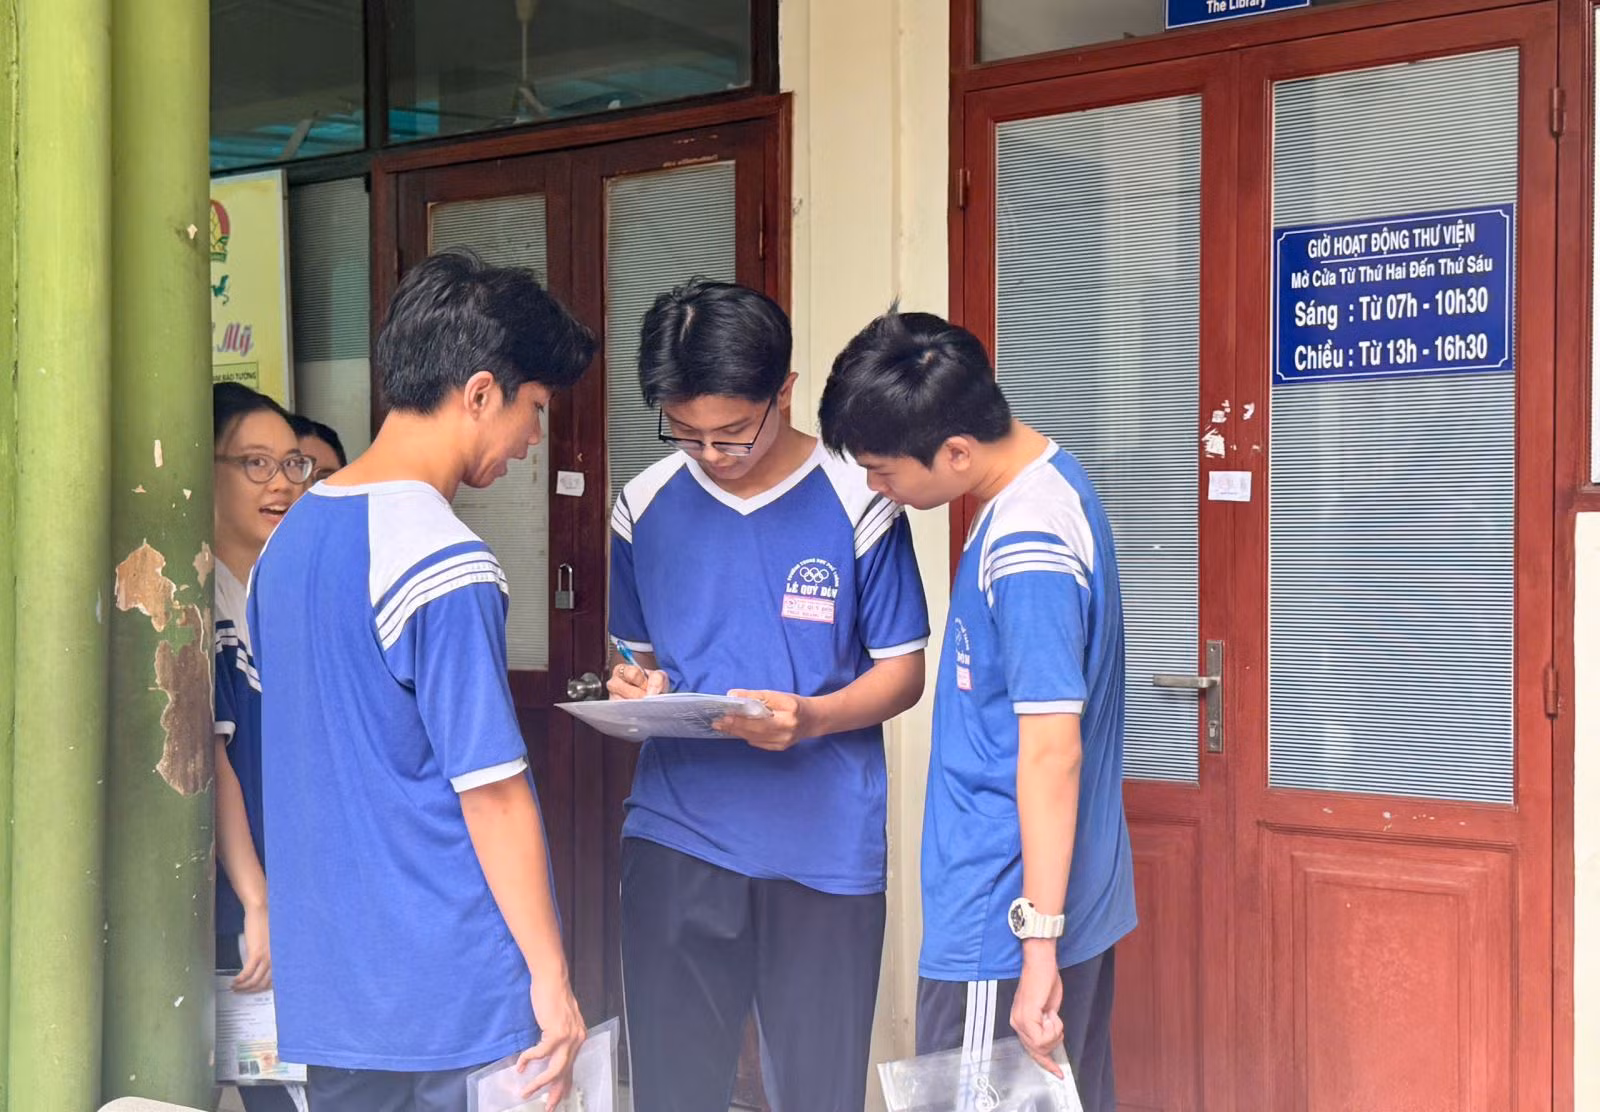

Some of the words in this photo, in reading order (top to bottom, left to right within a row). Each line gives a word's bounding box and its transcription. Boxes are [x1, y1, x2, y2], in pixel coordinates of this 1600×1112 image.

[1206, 0, 1226, 13] The
[1229, 0, 1265, 10] Library
[1308, 234, 1331, 258] GIỜ
[1334, 234, 1368, 257] HOẠT
[1371, 227, 1410, 255] ĐỘNG
[1412, 224, 1441, 248] THƯ
[1443, 219, 1475, 248] VIỆN
[1291, 270, 1310, 289] Mở
[1312, 268, 1336, 287] Cửa
[1339, 267, 1356, 285] Từ
[1358, 264, 1383, 283] Thứ
[1386, 262, 1406, 280] Hai
[1409, 258, 1435, 278] Đến
[1438, 256, 1465, 275] Thứ
[1467, 254, 1493, 273] Sáu
[1295, 300, 1338, 331] Sáng
[1359, 295, 1383, 321] Từ
[1386, 292, 1418, 320] 07h
[1435, 287, 1488, 316] 10h30
[217, 322, 254, 357] Mỹ
[1294, 339, 1343, 371] Chiều
[1358, 340, 1383, 366] Từ
[1387, 338, 1417, 365] 13h
[1434, 333, 1488, 361] 16h30
